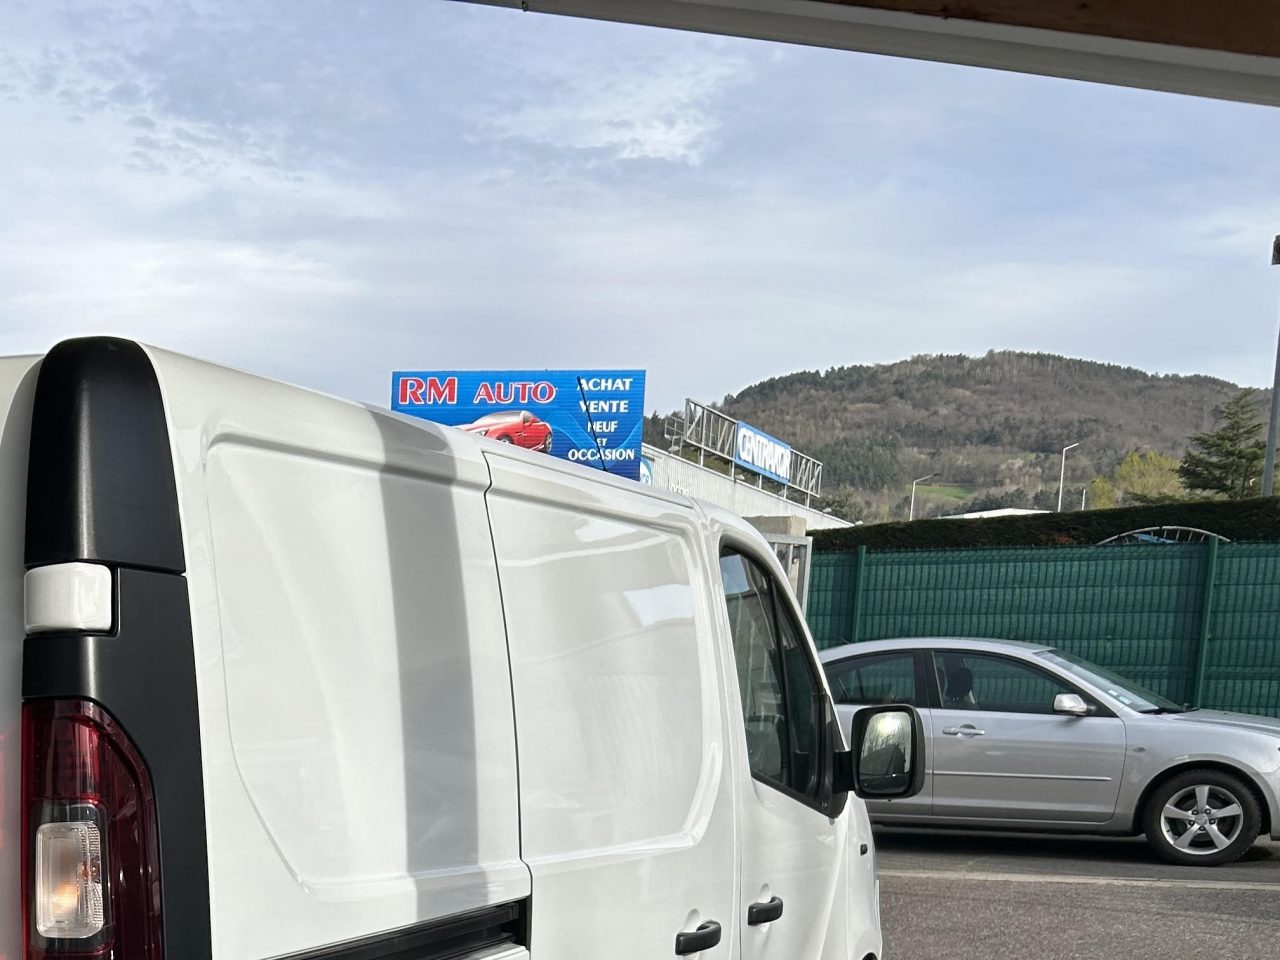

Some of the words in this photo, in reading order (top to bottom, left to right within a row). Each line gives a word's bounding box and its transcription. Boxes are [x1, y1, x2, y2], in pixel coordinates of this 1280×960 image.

[399, 377, 457, 404] RM
[473, 381, 556, 403] AUTO
[577, 378, 633, 391] ACHAT
[579, 400, 629, 413] VENTE
[588, 421, 618, 432] NEUF
[596, 438, 608, 446] ET
[568, 448, 634, 461] OCCASION
